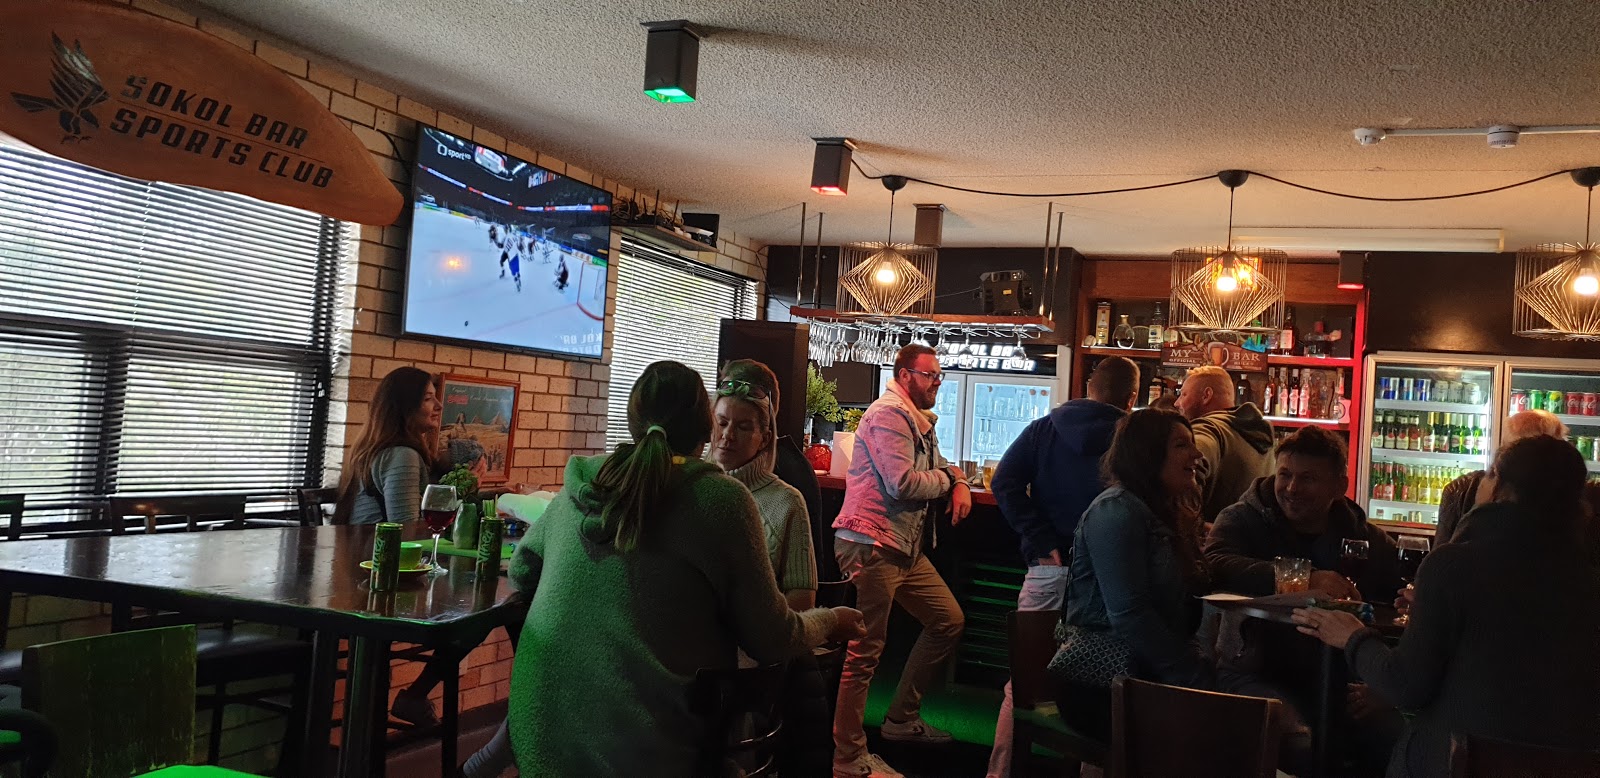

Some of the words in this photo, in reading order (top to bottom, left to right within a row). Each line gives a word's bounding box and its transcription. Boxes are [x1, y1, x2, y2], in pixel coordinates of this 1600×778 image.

[121, 74, 232, 128] SOKOL
[245, 113, 308, 149] BAR
[110, 108, 252, 166] SPORTS
[258, 151, 334, 188] CLUB
[1170, 349, 1192, 358] MY
[1233, 352, 1260, 361] BAR
